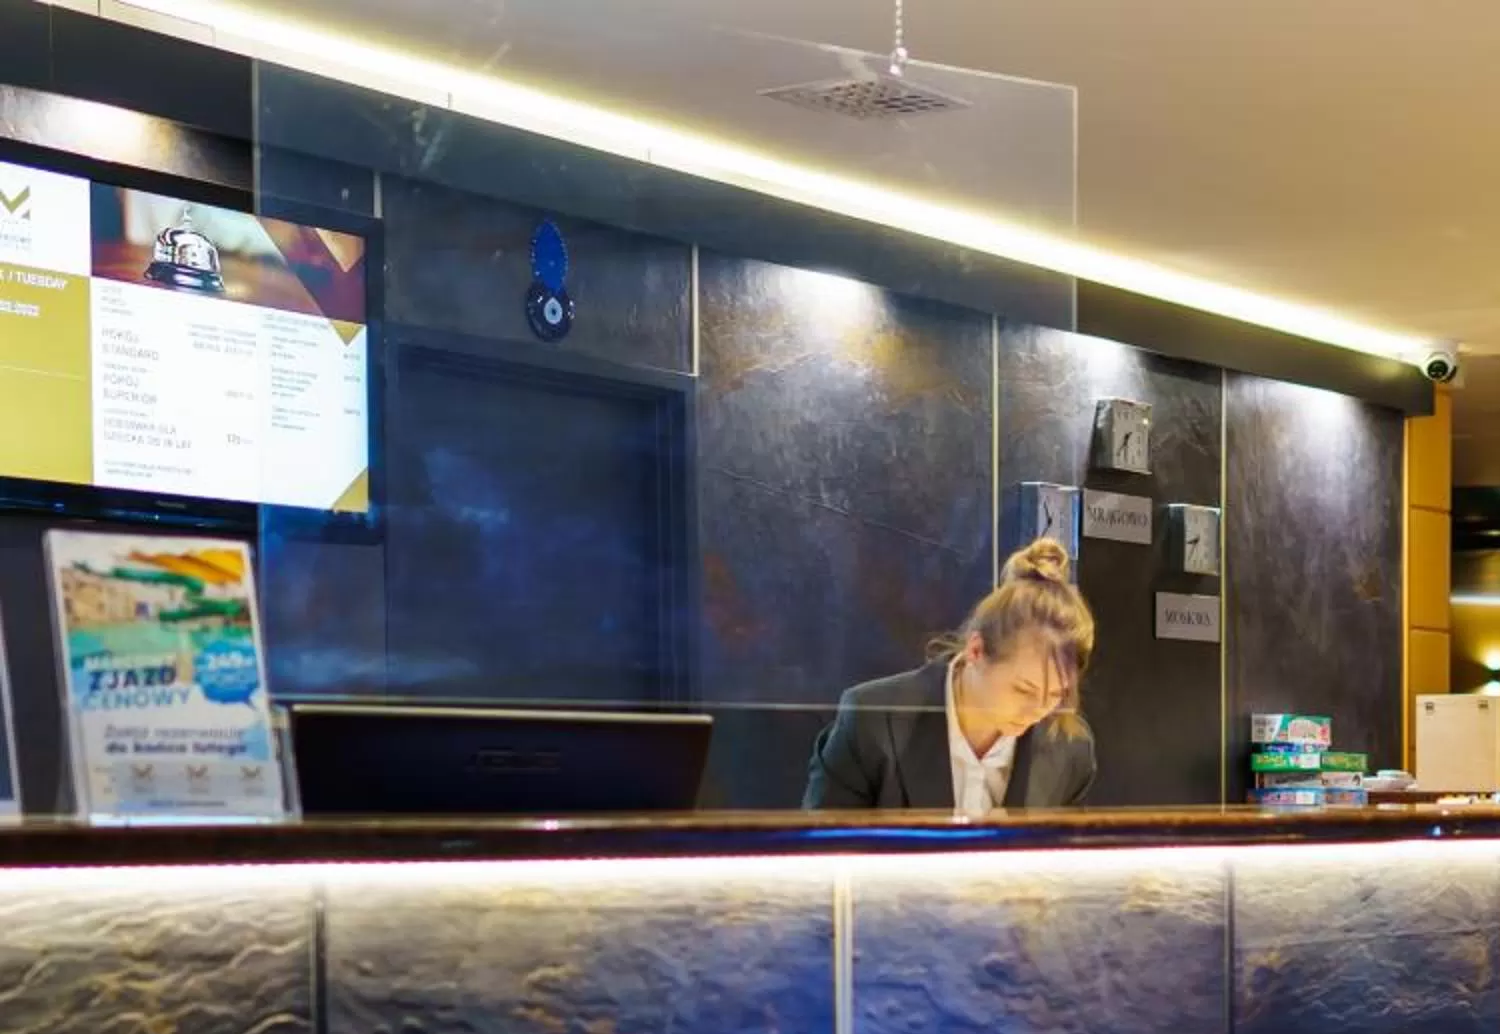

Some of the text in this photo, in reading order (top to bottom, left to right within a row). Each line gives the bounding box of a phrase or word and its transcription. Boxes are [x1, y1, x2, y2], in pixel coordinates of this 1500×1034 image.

[16, 271, 68, 291] TUESDAY
[102, 343, 159, 361] STANDARD
[103, 387, 157, 405] SUPERIOR
[89, 666, 176, 693] ZJAZD
[81, 687, 191, 710] CENOWY
